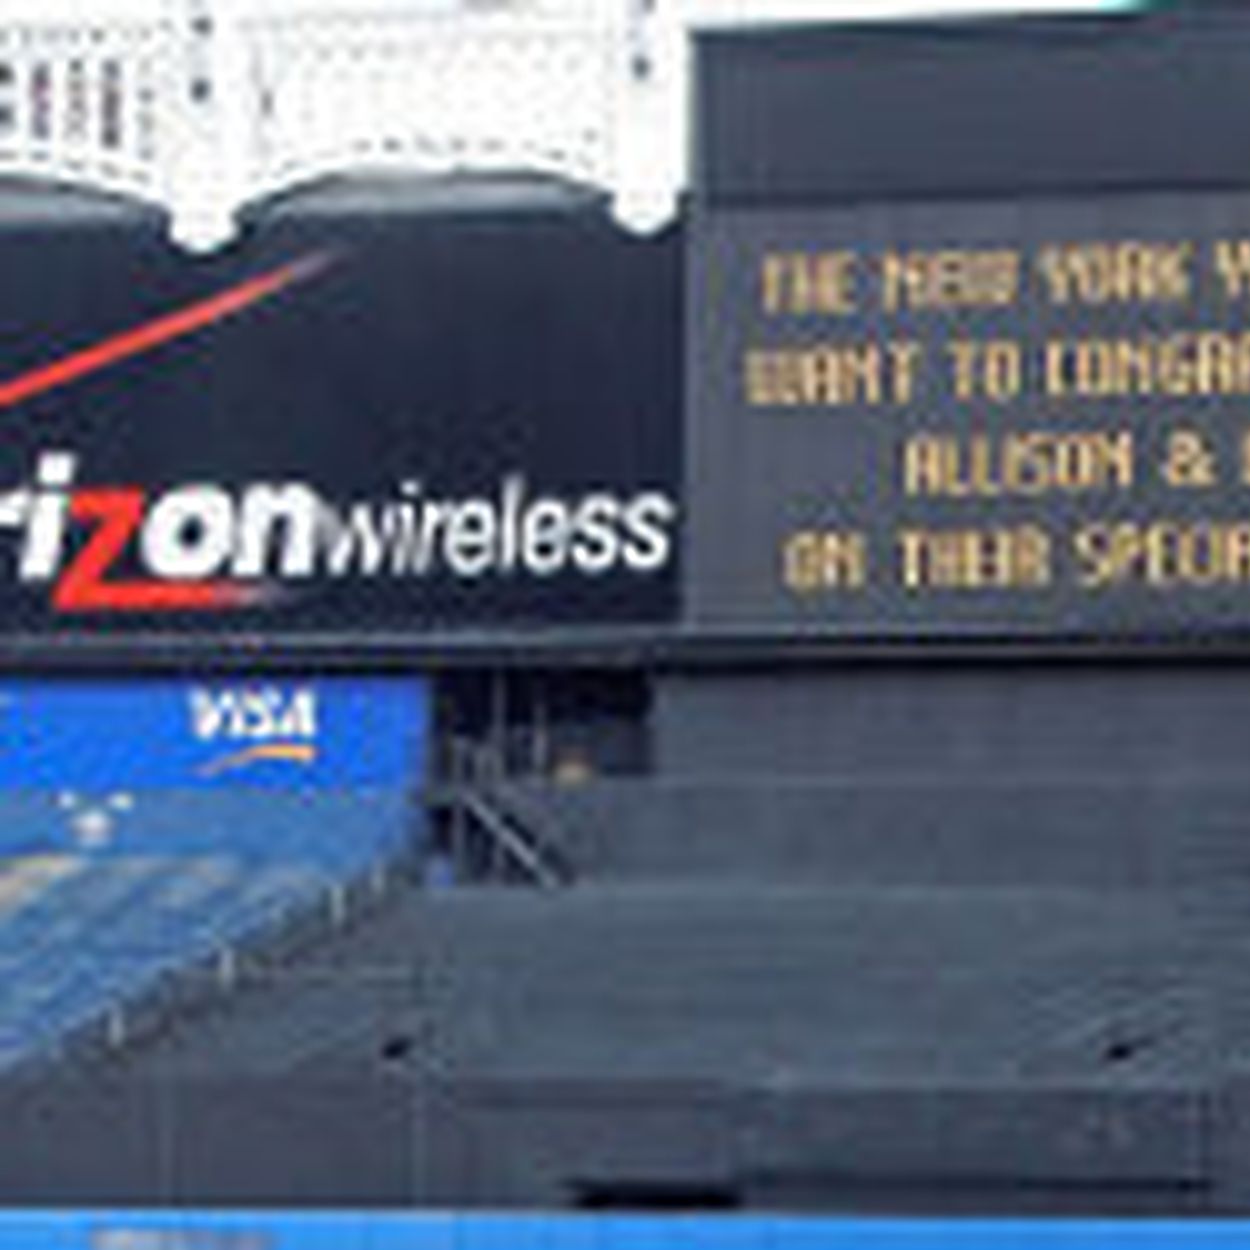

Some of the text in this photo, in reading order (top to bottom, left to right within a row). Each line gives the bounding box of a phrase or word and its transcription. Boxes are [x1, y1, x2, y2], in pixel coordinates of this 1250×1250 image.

[761, 251, 856, 314] THE
[883, 250, 1019, 310] NEW
[1040, 241, 1190, 303] YORK
[746, 340, 920, 404] WANT
[950, 338, 1019, 398] TO
[904, 430, 1132, 495] ALLISON
[1162, 428, 1216, 486] &
[783, 529, 864, 588] ON
[900, 526, 1050, 588] THEIR
[189, 686, 316, 739] VISA
